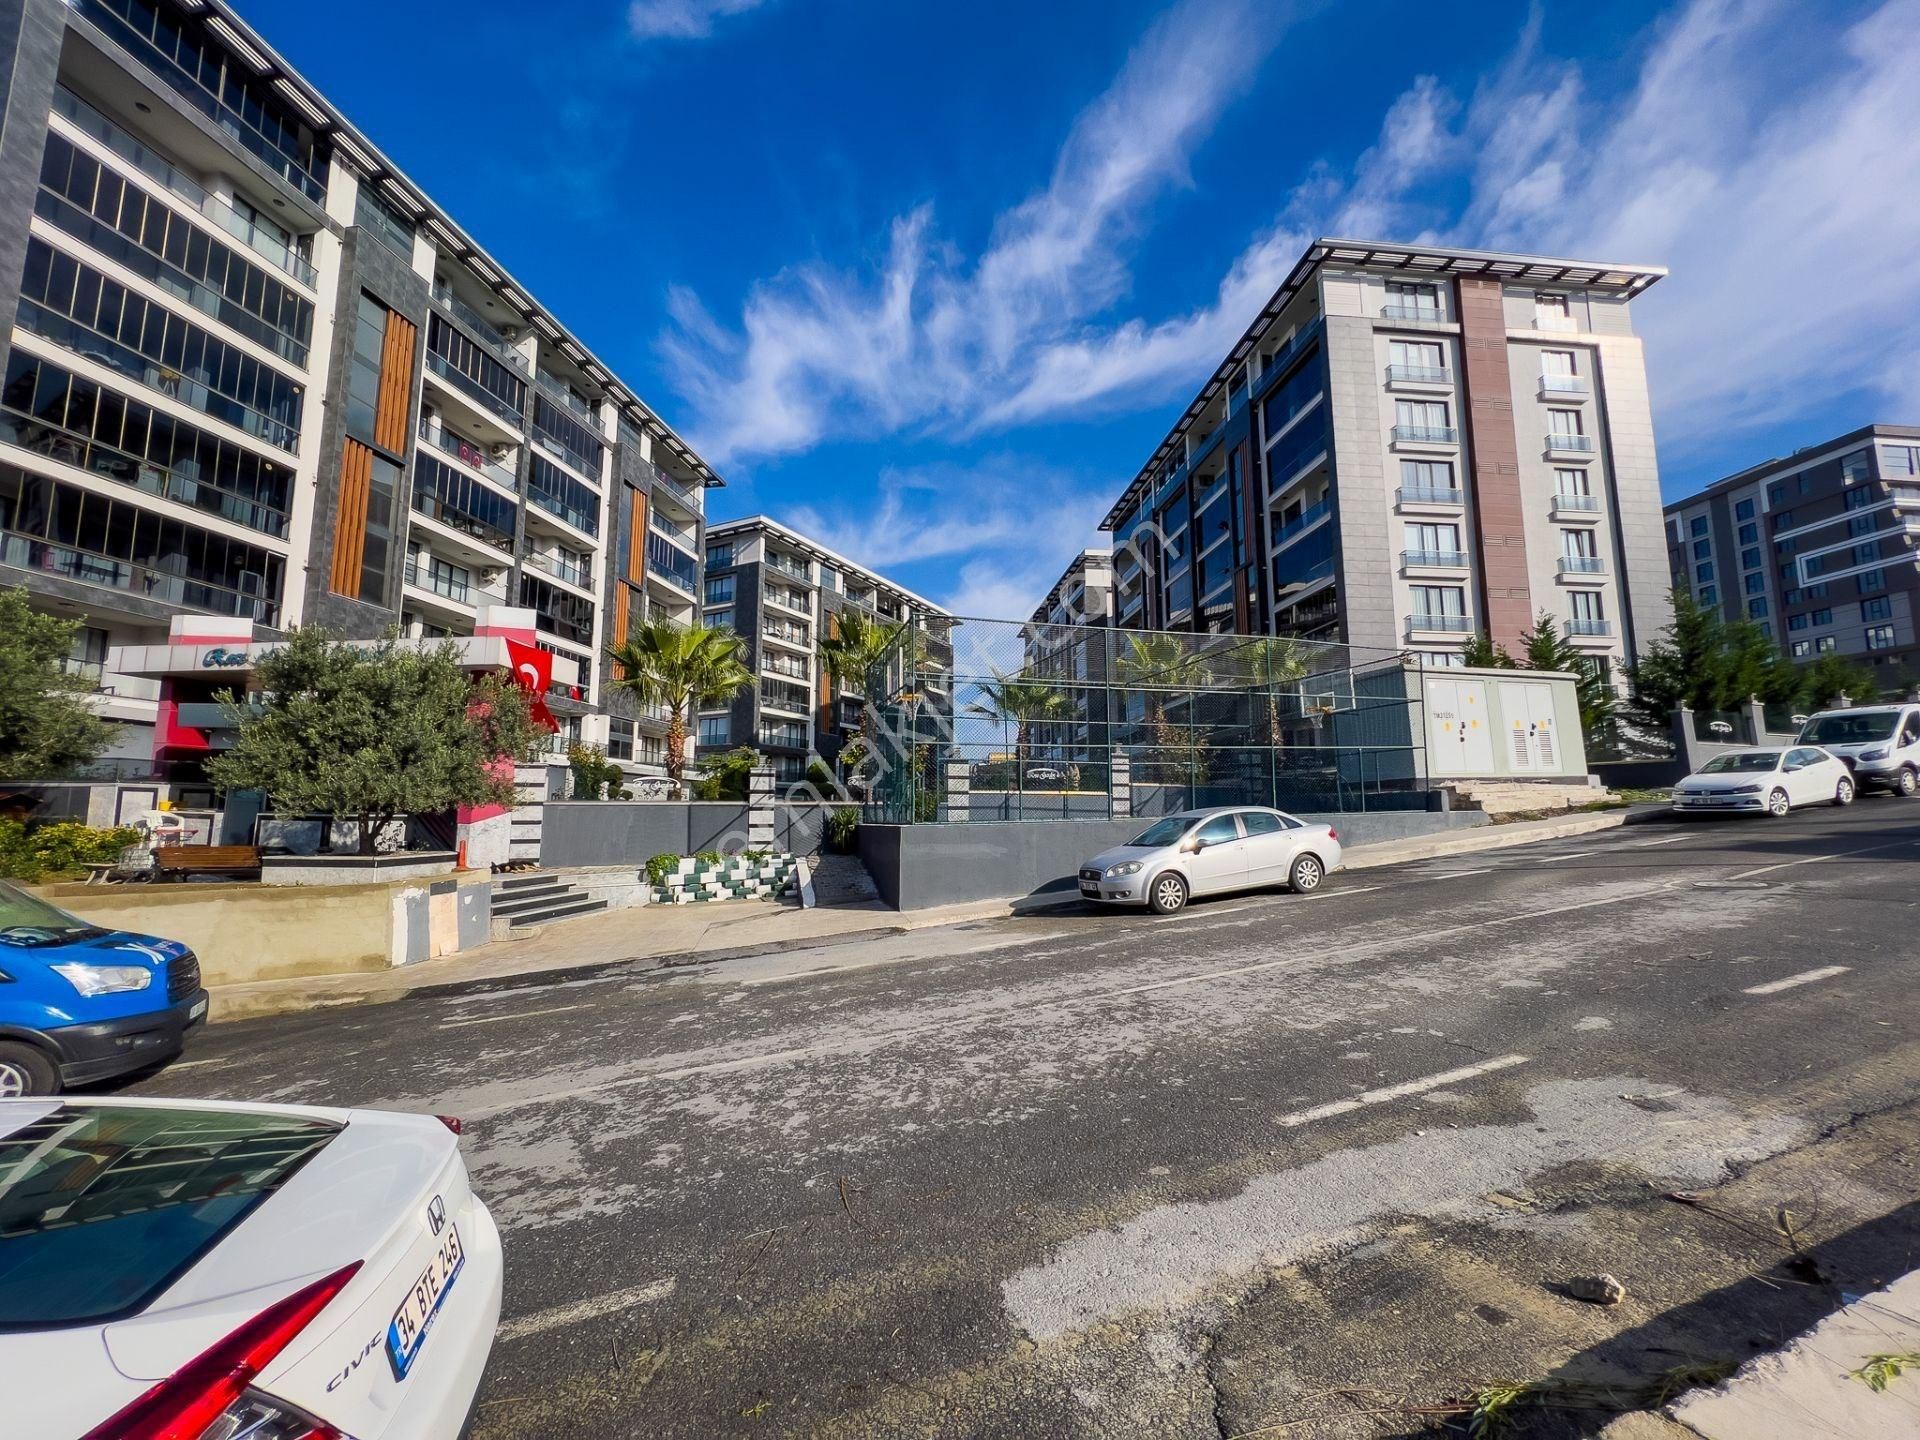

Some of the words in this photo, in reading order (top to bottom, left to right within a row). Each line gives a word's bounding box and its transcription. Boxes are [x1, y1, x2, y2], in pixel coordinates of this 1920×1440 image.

[397, 1308, 415, 1350] 34
[416, 1264, 439, 1319] BTE
[438, 1232, 458, 1279] 246
[326, 1330, 382, 1393] CIVIC
